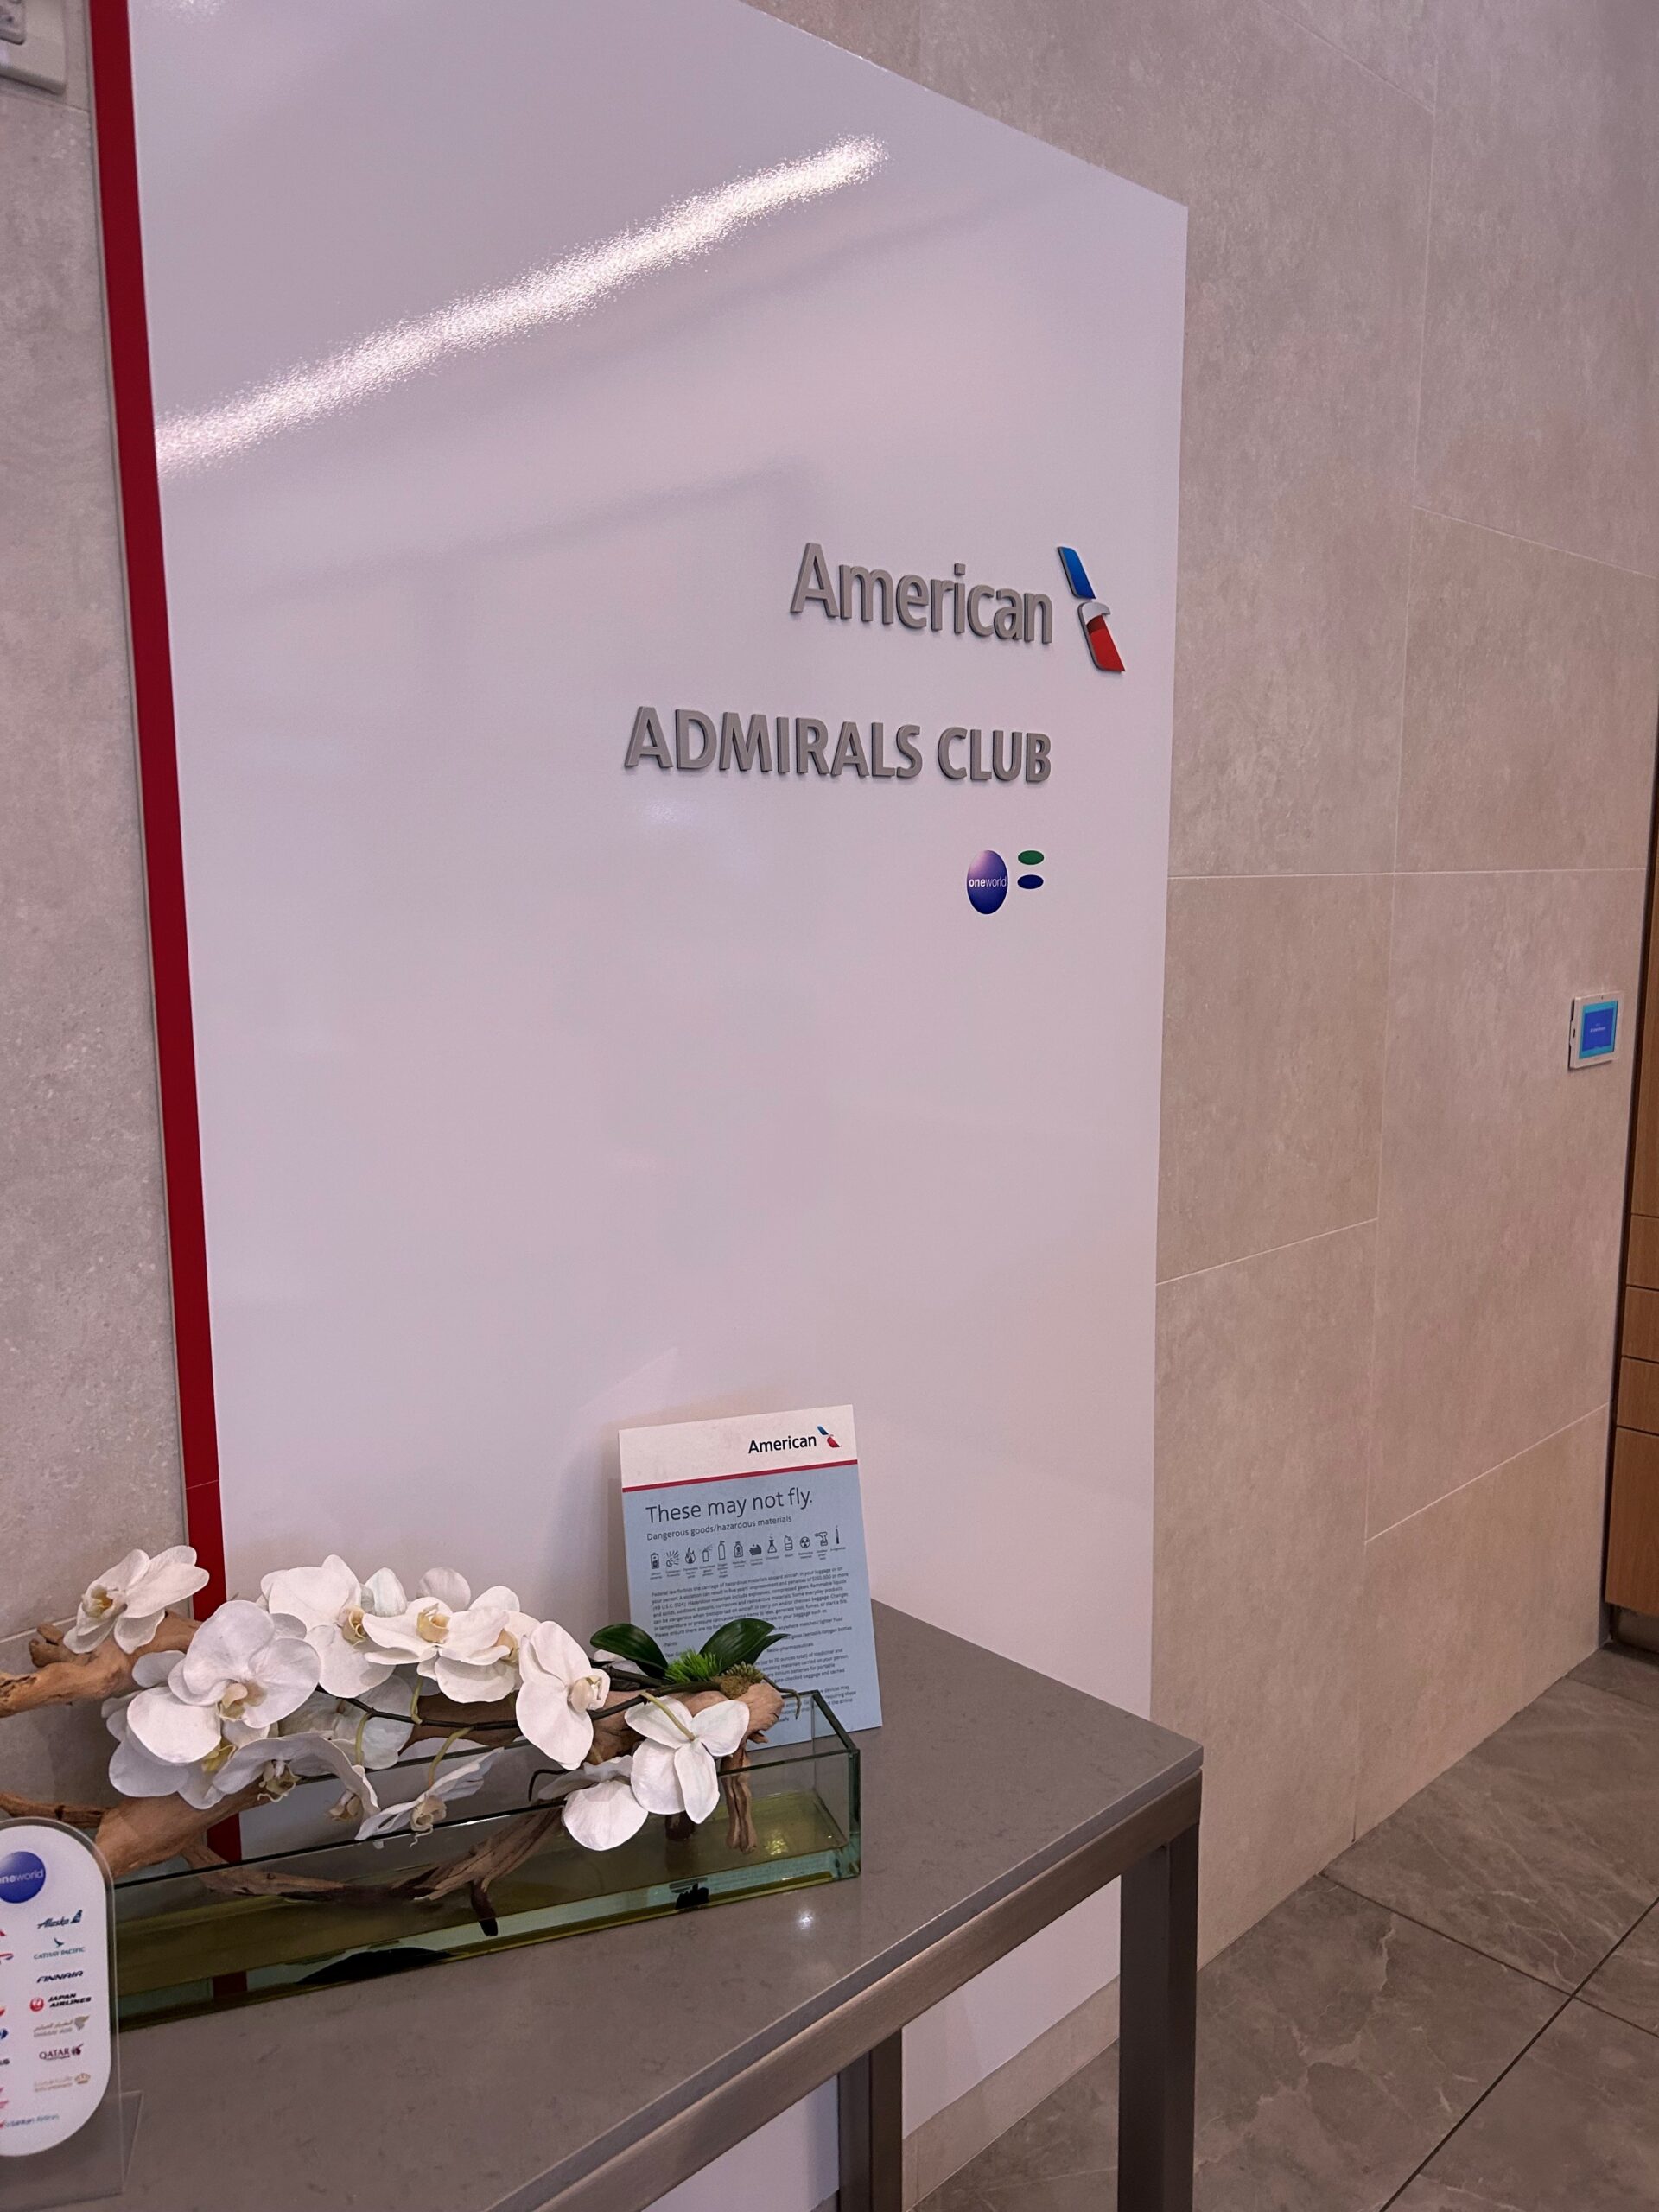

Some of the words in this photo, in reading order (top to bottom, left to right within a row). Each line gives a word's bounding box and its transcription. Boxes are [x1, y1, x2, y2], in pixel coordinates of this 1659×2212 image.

[791, 543, 1053, 645] American
[625, 706, 923, 779] ADMIRALS
[938, 727, 1052, 783] CLUB
[969, 876, 1007, 887] oneworld
[748, 1435, 817, 1454] American
[646, 1504, 701, 1523] These
[708, 1498, 747, 1517] may
[753, 1492, 784, 1510] not
[788, 1487, 813, 1510] fly.
[646, 1529, 689, 1541] Dangerous
[690, 1521, 756, 1537] goods/hazardous
[758, 1515, 792, 1527] materials
[37, 1916, 70, 1929] Alaska
[36, 1970, 84, 1983] FINNAIR
[48, 1993, 76, 2002] JAPAN
[49, 1997, 92, 2008] AIRLINES
[39, 2048, 70, 2060] QATAR
